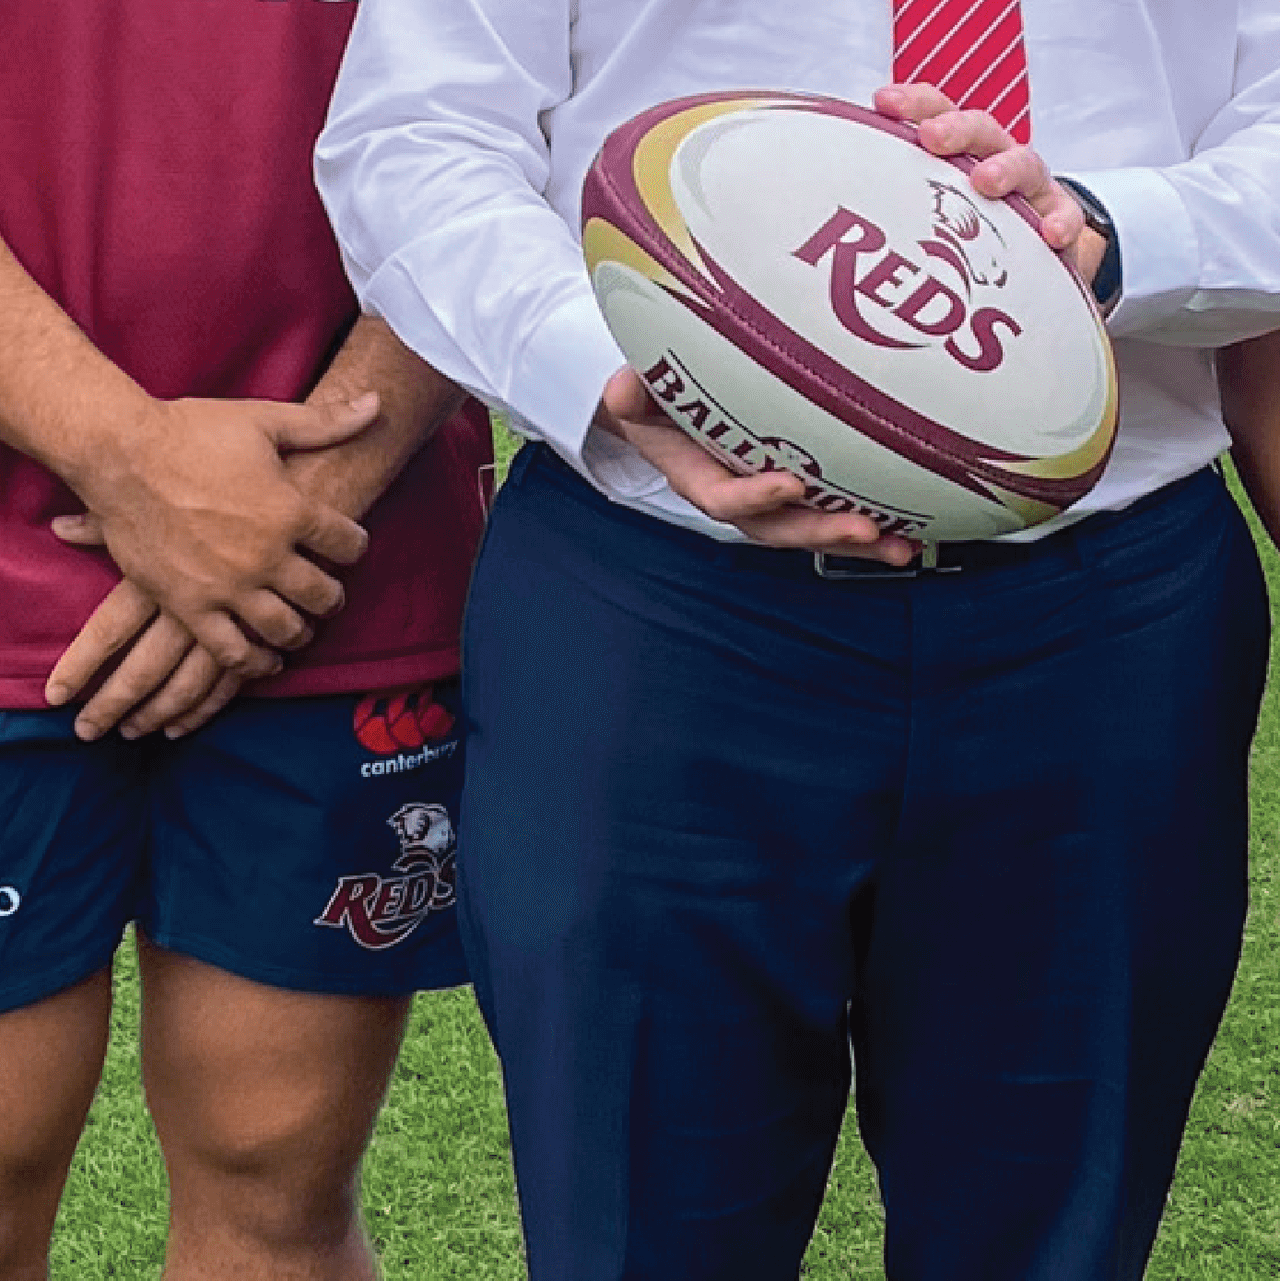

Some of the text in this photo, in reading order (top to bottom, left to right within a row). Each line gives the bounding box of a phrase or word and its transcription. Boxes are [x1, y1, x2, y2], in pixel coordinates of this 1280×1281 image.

[789, 203, 1024, 374] REDS
[644, 354, 933, 545] BALLYOE
[360, 738, 459, 778] canterbury
